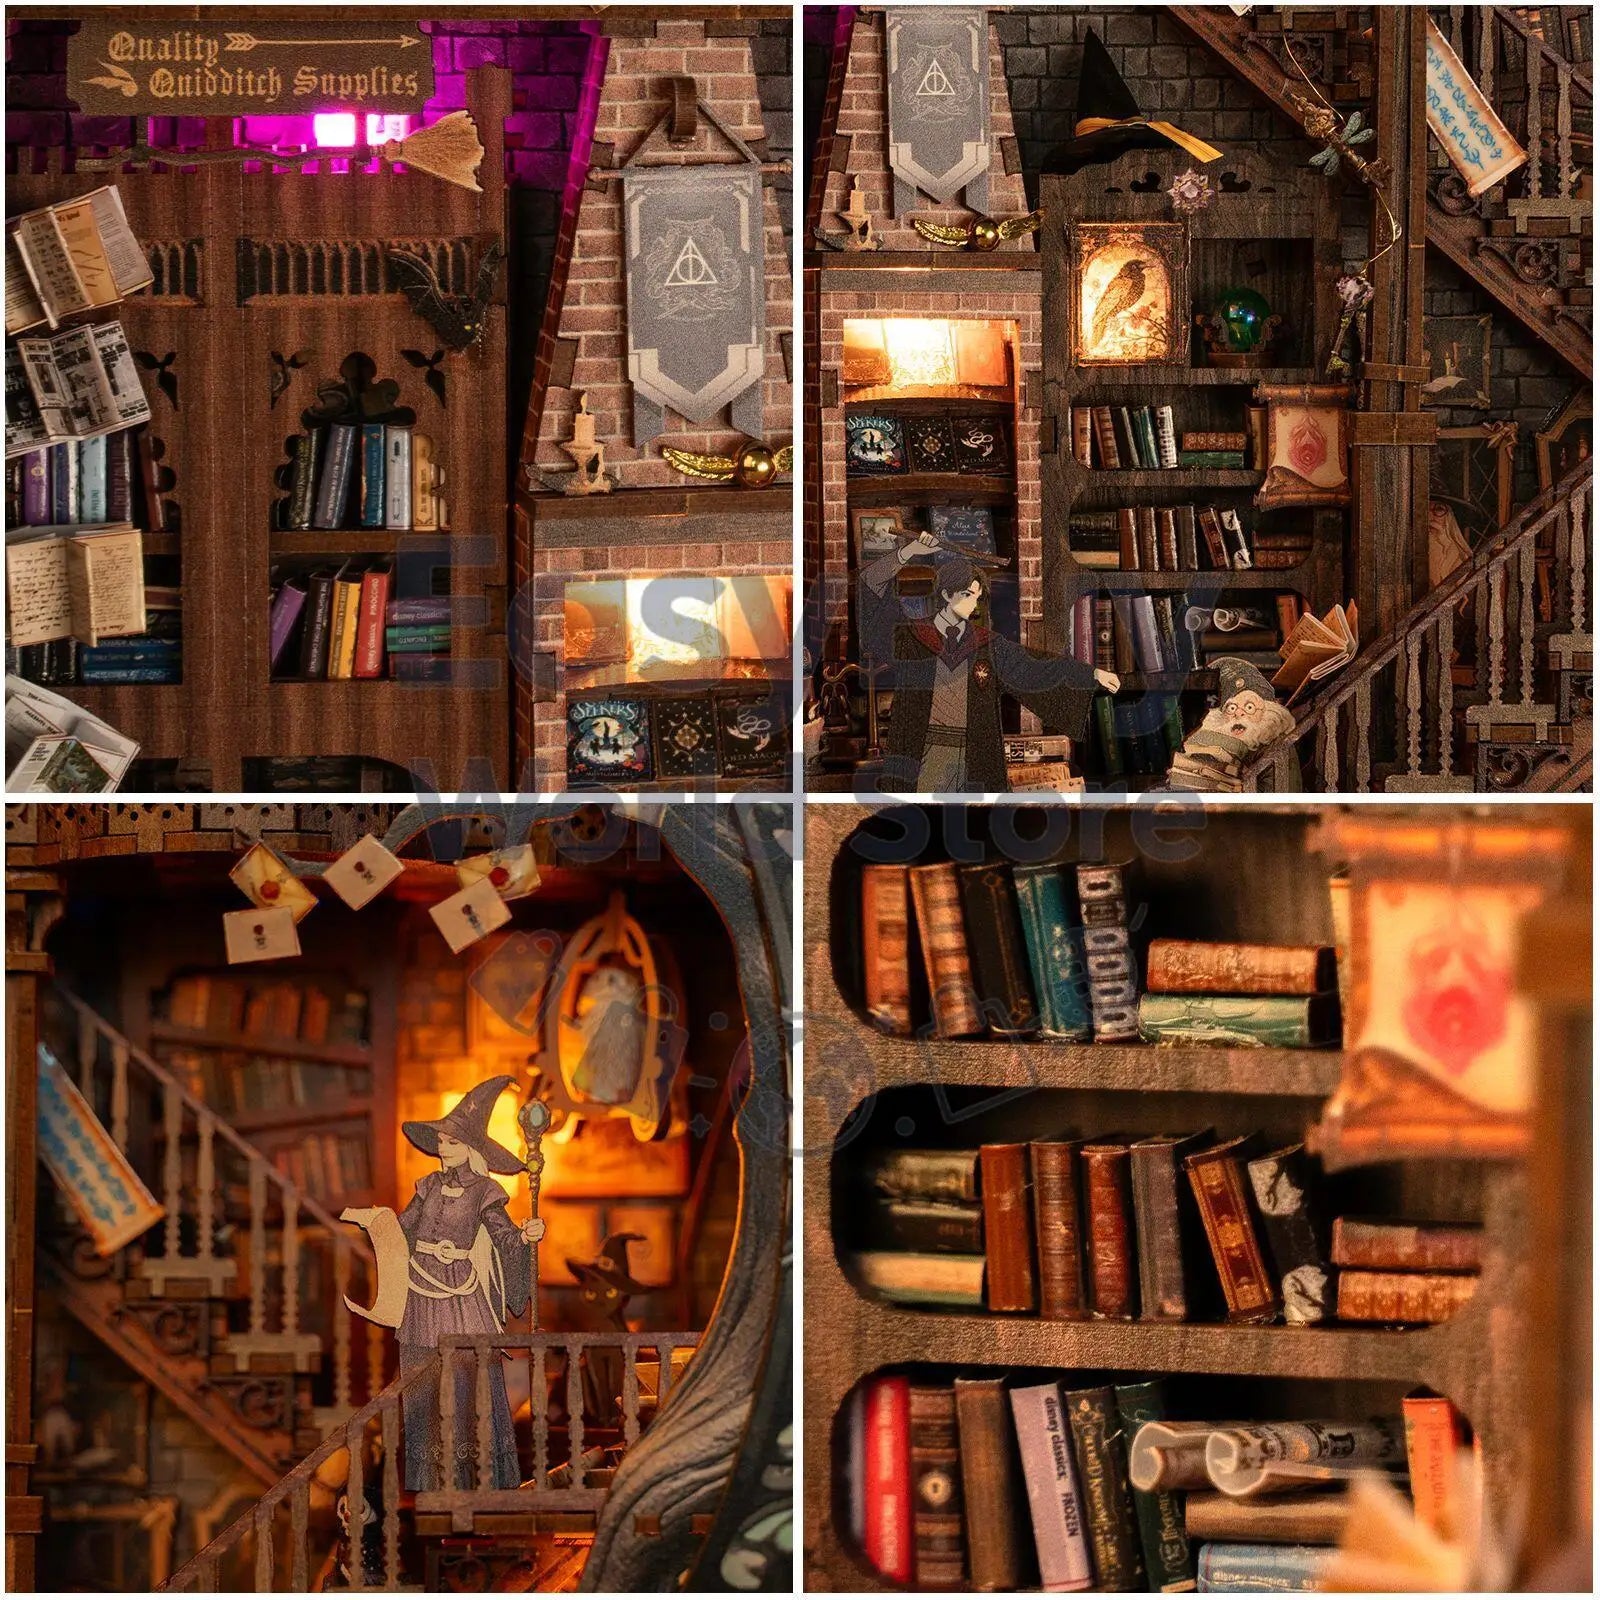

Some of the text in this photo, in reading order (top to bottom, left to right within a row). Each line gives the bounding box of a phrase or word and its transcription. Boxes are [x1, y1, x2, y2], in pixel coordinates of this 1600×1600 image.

[108, 31, 219, 67] Quality
[149, 65, 418, 103] Quidditch Supplies
[367, 578, 381, 616] PINOCCHIO
[1041, 1396, 1062, 1433] disney
[1060, 1491, 1081, 1538] FROZEN
